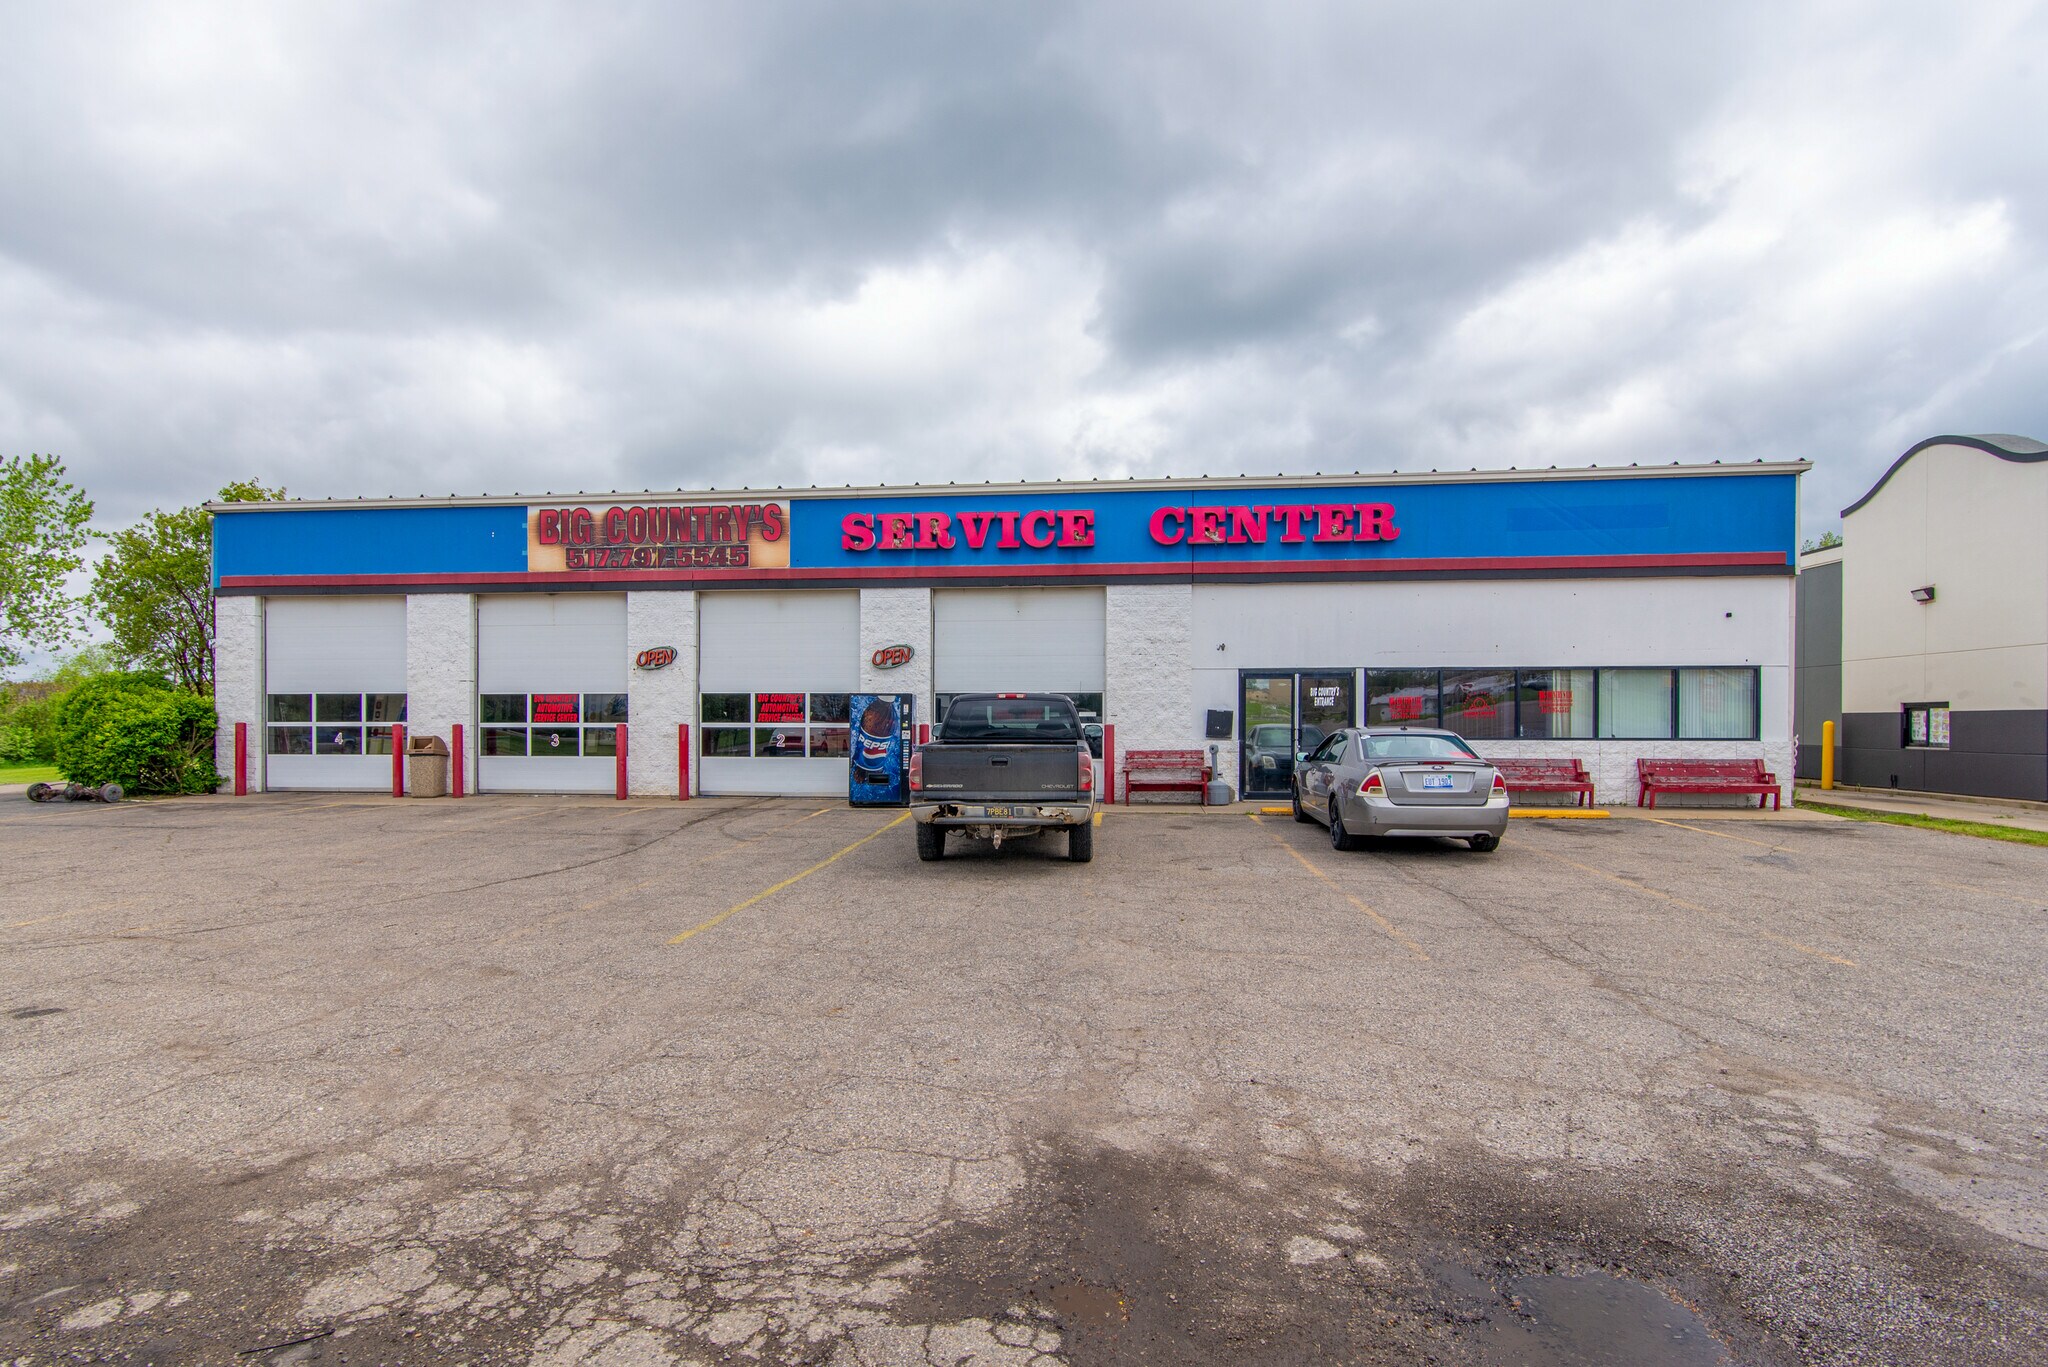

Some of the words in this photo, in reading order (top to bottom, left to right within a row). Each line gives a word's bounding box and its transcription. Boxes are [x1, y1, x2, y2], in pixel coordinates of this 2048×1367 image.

[539, 507, 593, 545] BIG
[605, 503, 783, 544] COUNTRY'S
[841, 509, 1095, 551] SERVICE
[1149, 502, 1401, 545] CENTER
[637, 649, 673, 667] OPEN
[872, 647, 911, 666] OPEN
[537, 703, 574, 713] AUTOMOTIVE
[760, 703, 799, 713] AUTOMOTIVE
[533, 713, 556, 723] SERVICE
[557, 713, 578, 723] CENTER
[334, 731, 344, 745] 4
[550, 733, 560, 747] 3
[776, 733, 786, 748] 2
[858, 733, 891, 750] PEPSI
